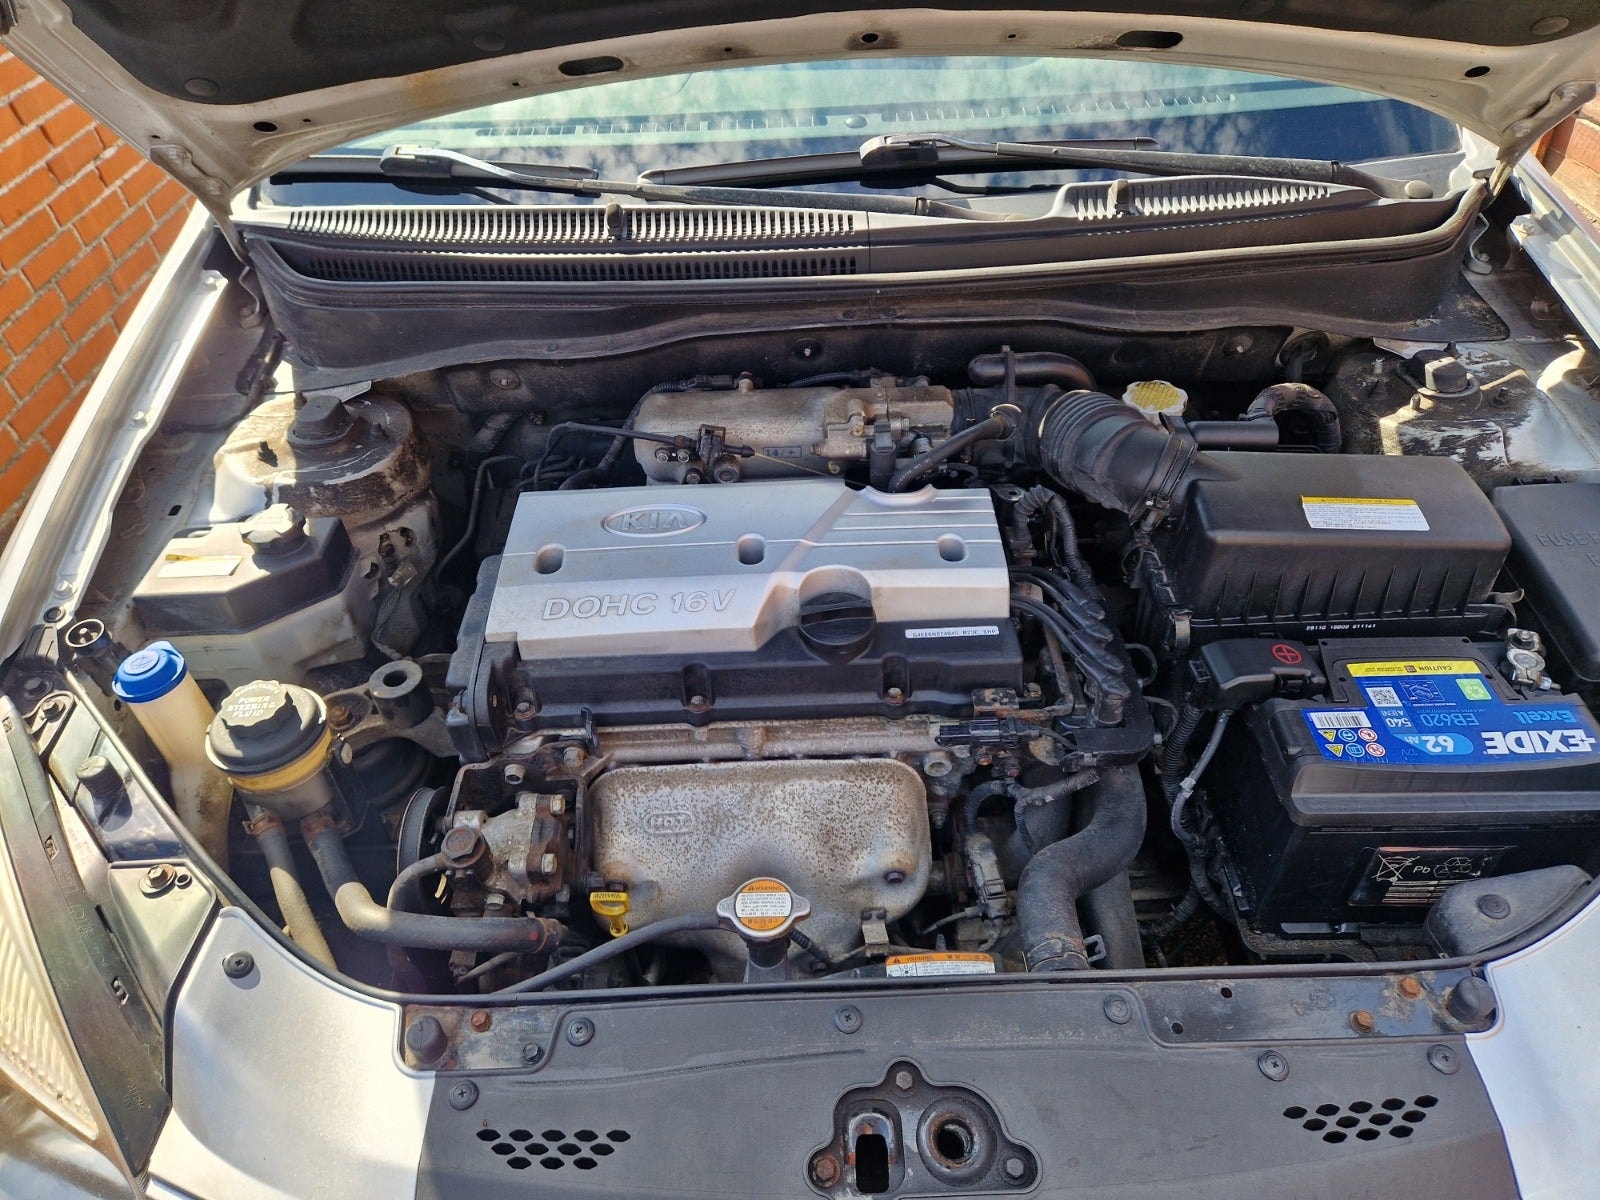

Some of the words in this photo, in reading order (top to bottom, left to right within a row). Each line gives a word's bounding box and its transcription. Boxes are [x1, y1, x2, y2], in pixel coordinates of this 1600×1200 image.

[620, 509, 690, 532] KIA
[1535, 530, 1587, 548] FUSE
[541, 592, 659, 622] DOHC
[672, 588, 736, 614] 16V
[226, 701, 276, 712] STEERING
[232, 709, 264, 718] FLUID
[1385, 717, 1412, 728] 540
[1419, 713, 1480, 727] EB620
[1513, 709, 1577, 724] Excell
[1420, 734, 1455, 753] 62
[1481, 728, 1596, 755] EXIDE
[1412, 865, 1431, 873] Pb
